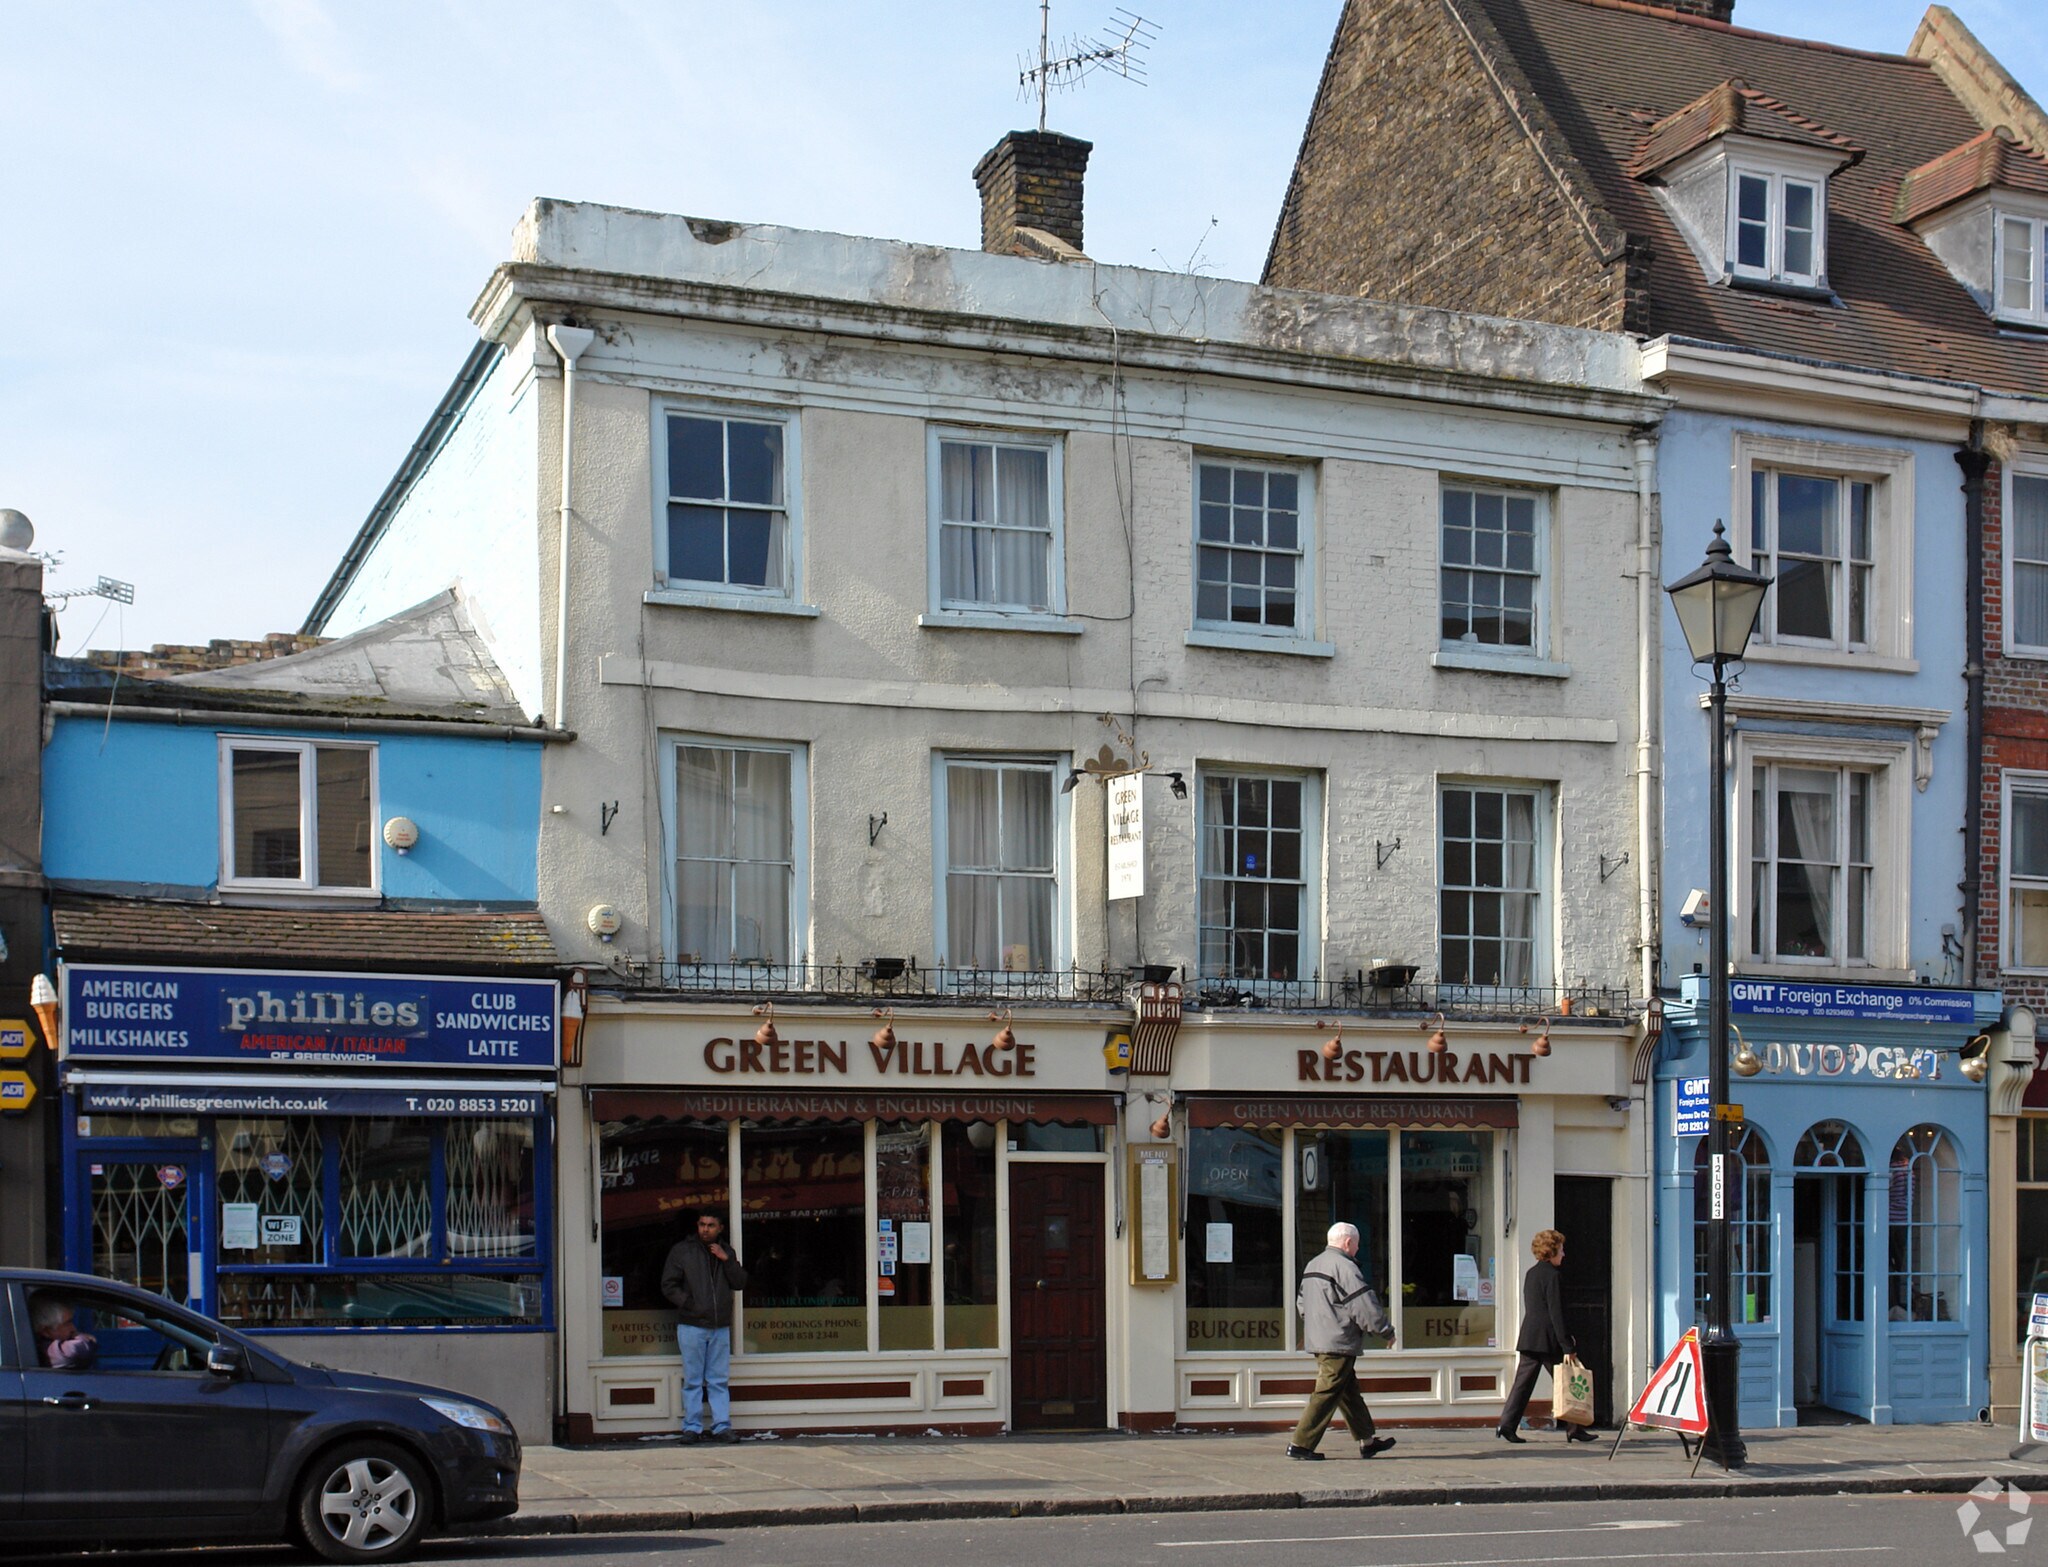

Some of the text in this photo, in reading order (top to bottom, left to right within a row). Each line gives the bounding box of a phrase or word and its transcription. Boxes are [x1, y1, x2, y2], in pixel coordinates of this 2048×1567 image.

[1115, 790, 1137, 805] GREEN
[1113, 809, 1139, 826] VILLAGE
[1110, 830, 1142, 846] RESTAURANT
[81, 980, 179, 999] AMERICAN
[1733, 984, 1776, 1001] GMT
[471, 993, 517, 1010] CLUB
[1779, 987, 1903, 1010] Foreign Exchange
[1908, 996, 1972, 1009] 0% Commission
[86, 1002, 174, 1020] BURGERS
[226, 990, 420, 1031] phillies
[1775, 1006, 1785, 1014] De
[1785, 1006, 1809, 1016] Change
[435, 1012, 551, 1031] SANDWICHES
[2, 1033, 23, 1044] ADT
[70, 1028, 189, 1048] MILKSHAKES
[240, 1034, 326, 1051] AMERICAN
[343, 1037, 407, 1053] ITALIAN
[468, 1039, 519, 1057] LATTE
[270, 1052, 377, 1062] OF GREENWICH
[703, 1037, 1036, 1077] GREEN VILLAGE
[1297, 1049, 1537, 1084] RESTAURANT
[2, 1085, 24, 1095] ADT
[1684, 1078, 1710, 1096] GMT
[90, 1094, 329, 1112] www.philliesgreenwich.co.uk
[426, 1098, 455, 1112] 020
[459, 1098, 496, 1112] 8853
[501, 1098, 536, 1113] 5201
[684, 1096, 1036, 1115] MEDITERRANEAN & ENGLISH CUISINE
[1233, 1103, 1475, 1119] GREEN VILLAGE RESTAURANT
[1140, 1150, 1168, 1159] MENU
[1209, 1167, 1249, 1181] OPEN
[267, 1234, 295, 1242] ZONE
[388, 1275, 443, 1283] SANDWICHES
[513, 1275, 537, 1283] LATTE
[387, 1318, 442, 1326] SANDWICHES
[452, 1318, 502, 1326] MILKSHAKES
[512, 1318, 536, 1326] LATTE
[611, 1323, 651, 1332] PARTIES
[747, 1319, 862, 1329] FOR BOOKINGS PHONE:
[1188, 1319, 1281, 1339] BURGERS
[1425, 1318, 1470, 1337] FISH
[623, 1334, 637, 1344] UP
[640, 1334, 655, 1343] TO
[771, 1332, 794, 1340] 0208
